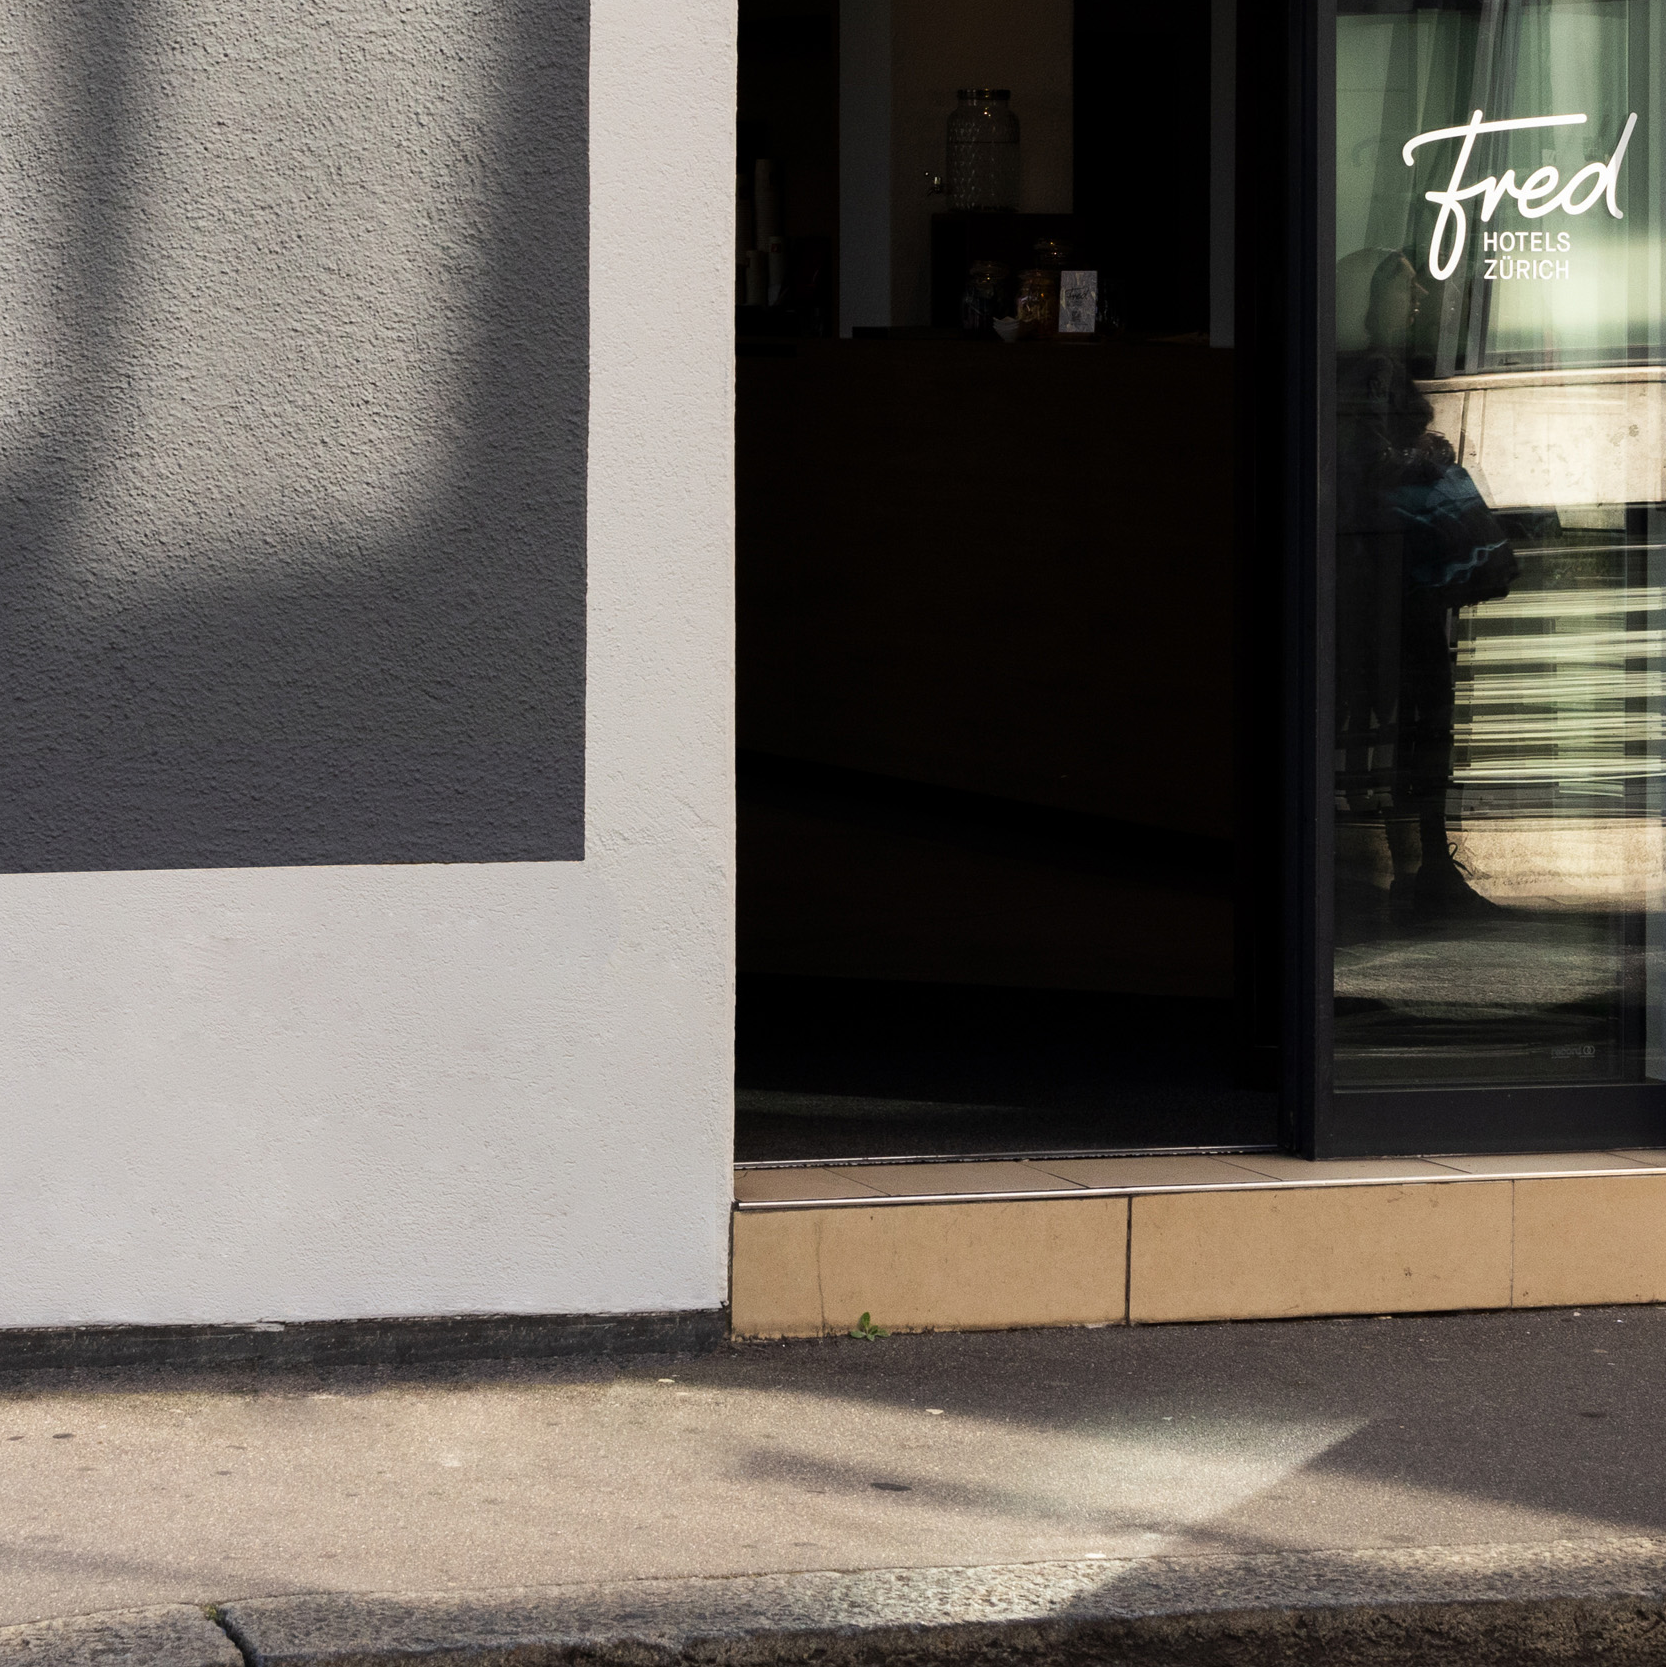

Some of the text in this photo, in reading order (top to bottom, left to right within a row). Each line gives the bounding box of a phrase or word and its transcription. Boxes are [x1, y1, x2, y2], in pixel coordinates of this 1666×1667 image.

[1402, 109, 1638, 281] Fred
[1483, 231, 1572, 253] HOTELS
[1483, 254, 1571, 281] ZÜRICH
